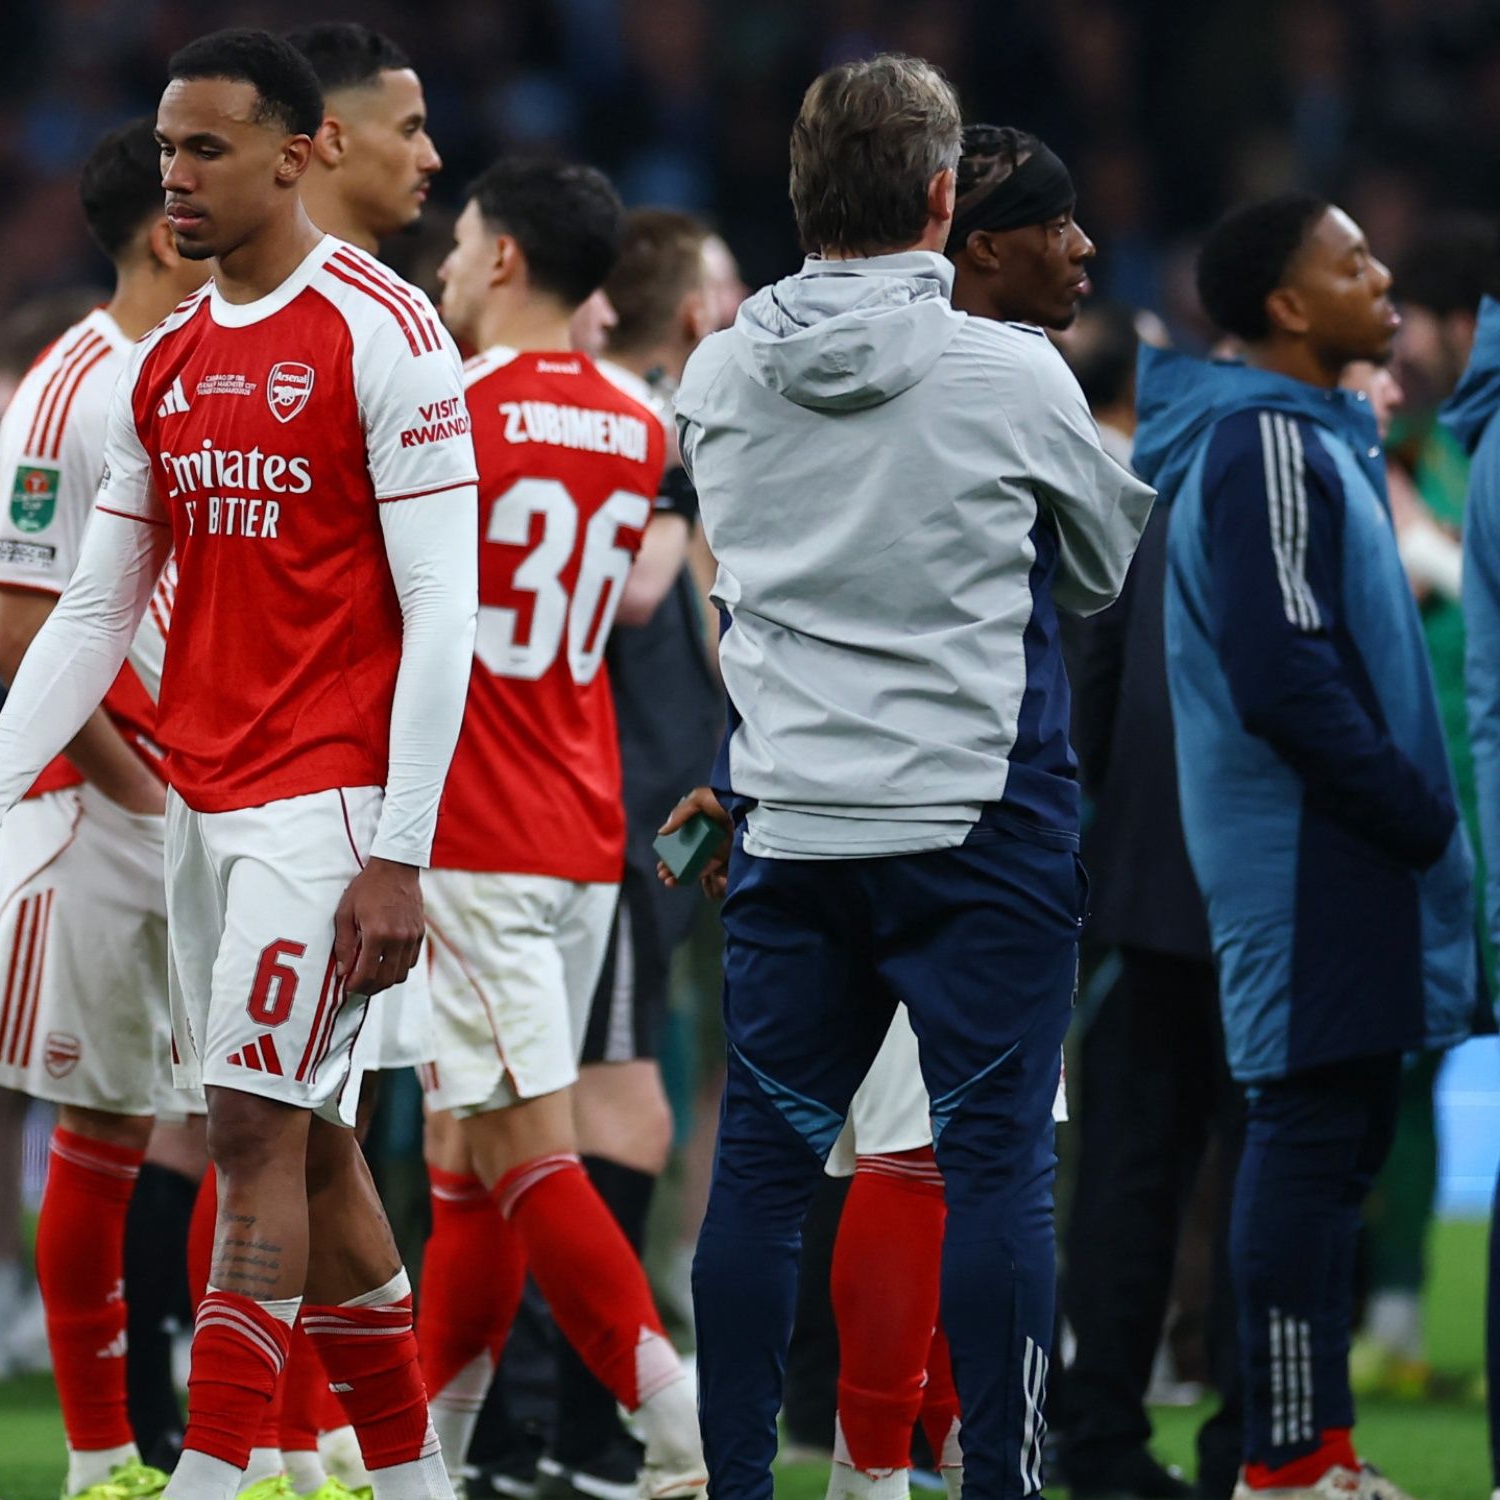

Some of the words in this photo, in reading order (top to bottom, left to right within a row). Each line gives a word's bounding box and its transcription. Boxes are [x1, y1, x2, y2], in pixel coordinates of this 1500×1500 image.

[275, 371, 308, 384] Arsenal
[400, 414, 469, 449] RWAND
[418, 396, 459, 422] VISIT
[499, 401, 649, 463] ZUBIMENDI
[160, 438, 313, 498] Emirates
[208, 496, 280, 539] BTTER
[474, 476, 651, 686] 36
[245, 937, 309, 1028] 6
